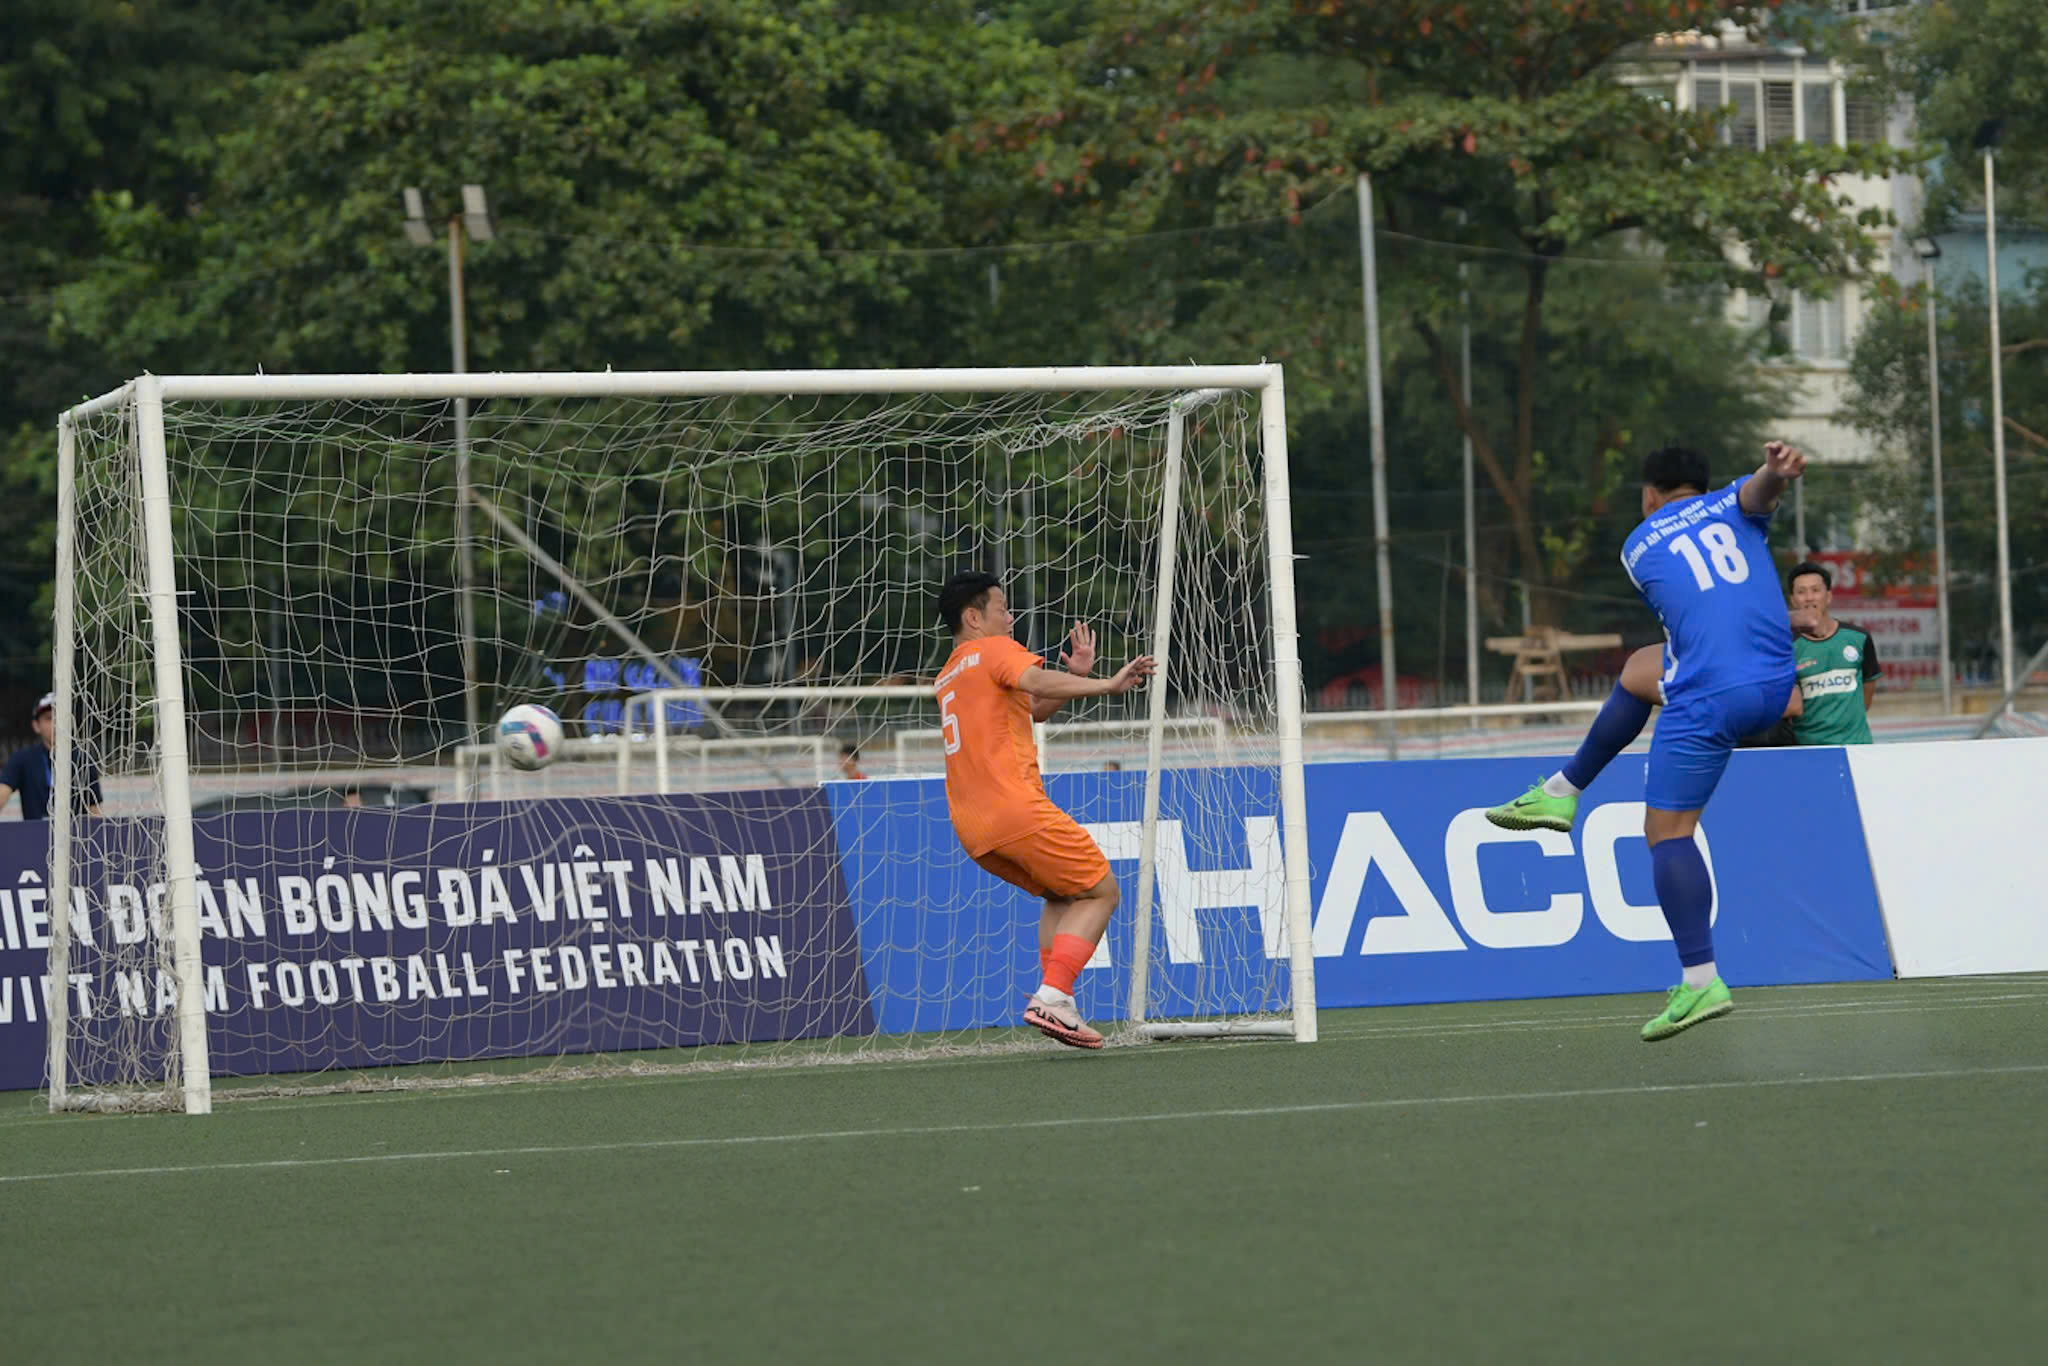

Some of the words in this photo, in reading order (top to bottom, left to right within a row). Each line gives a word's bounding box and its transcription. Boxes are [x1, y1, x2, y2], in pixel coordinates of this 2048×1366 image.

[1667, 522, 1750, 592] 18
[942, 690, 961, 756] 5
[0, 869, 94, 949] IÊN
[278, 856, 429, 935] BÓNG
[437, 849, 519, 927] ĐÁ
[519, 844, 634, 933] VIỆT
[645, 853, 772, 916] NAM
[115, 964, 229, 1018] NAM
[247, 952, 489, 1010] FOOTBALL
[503, 935, 788, 994] FEDERATION
